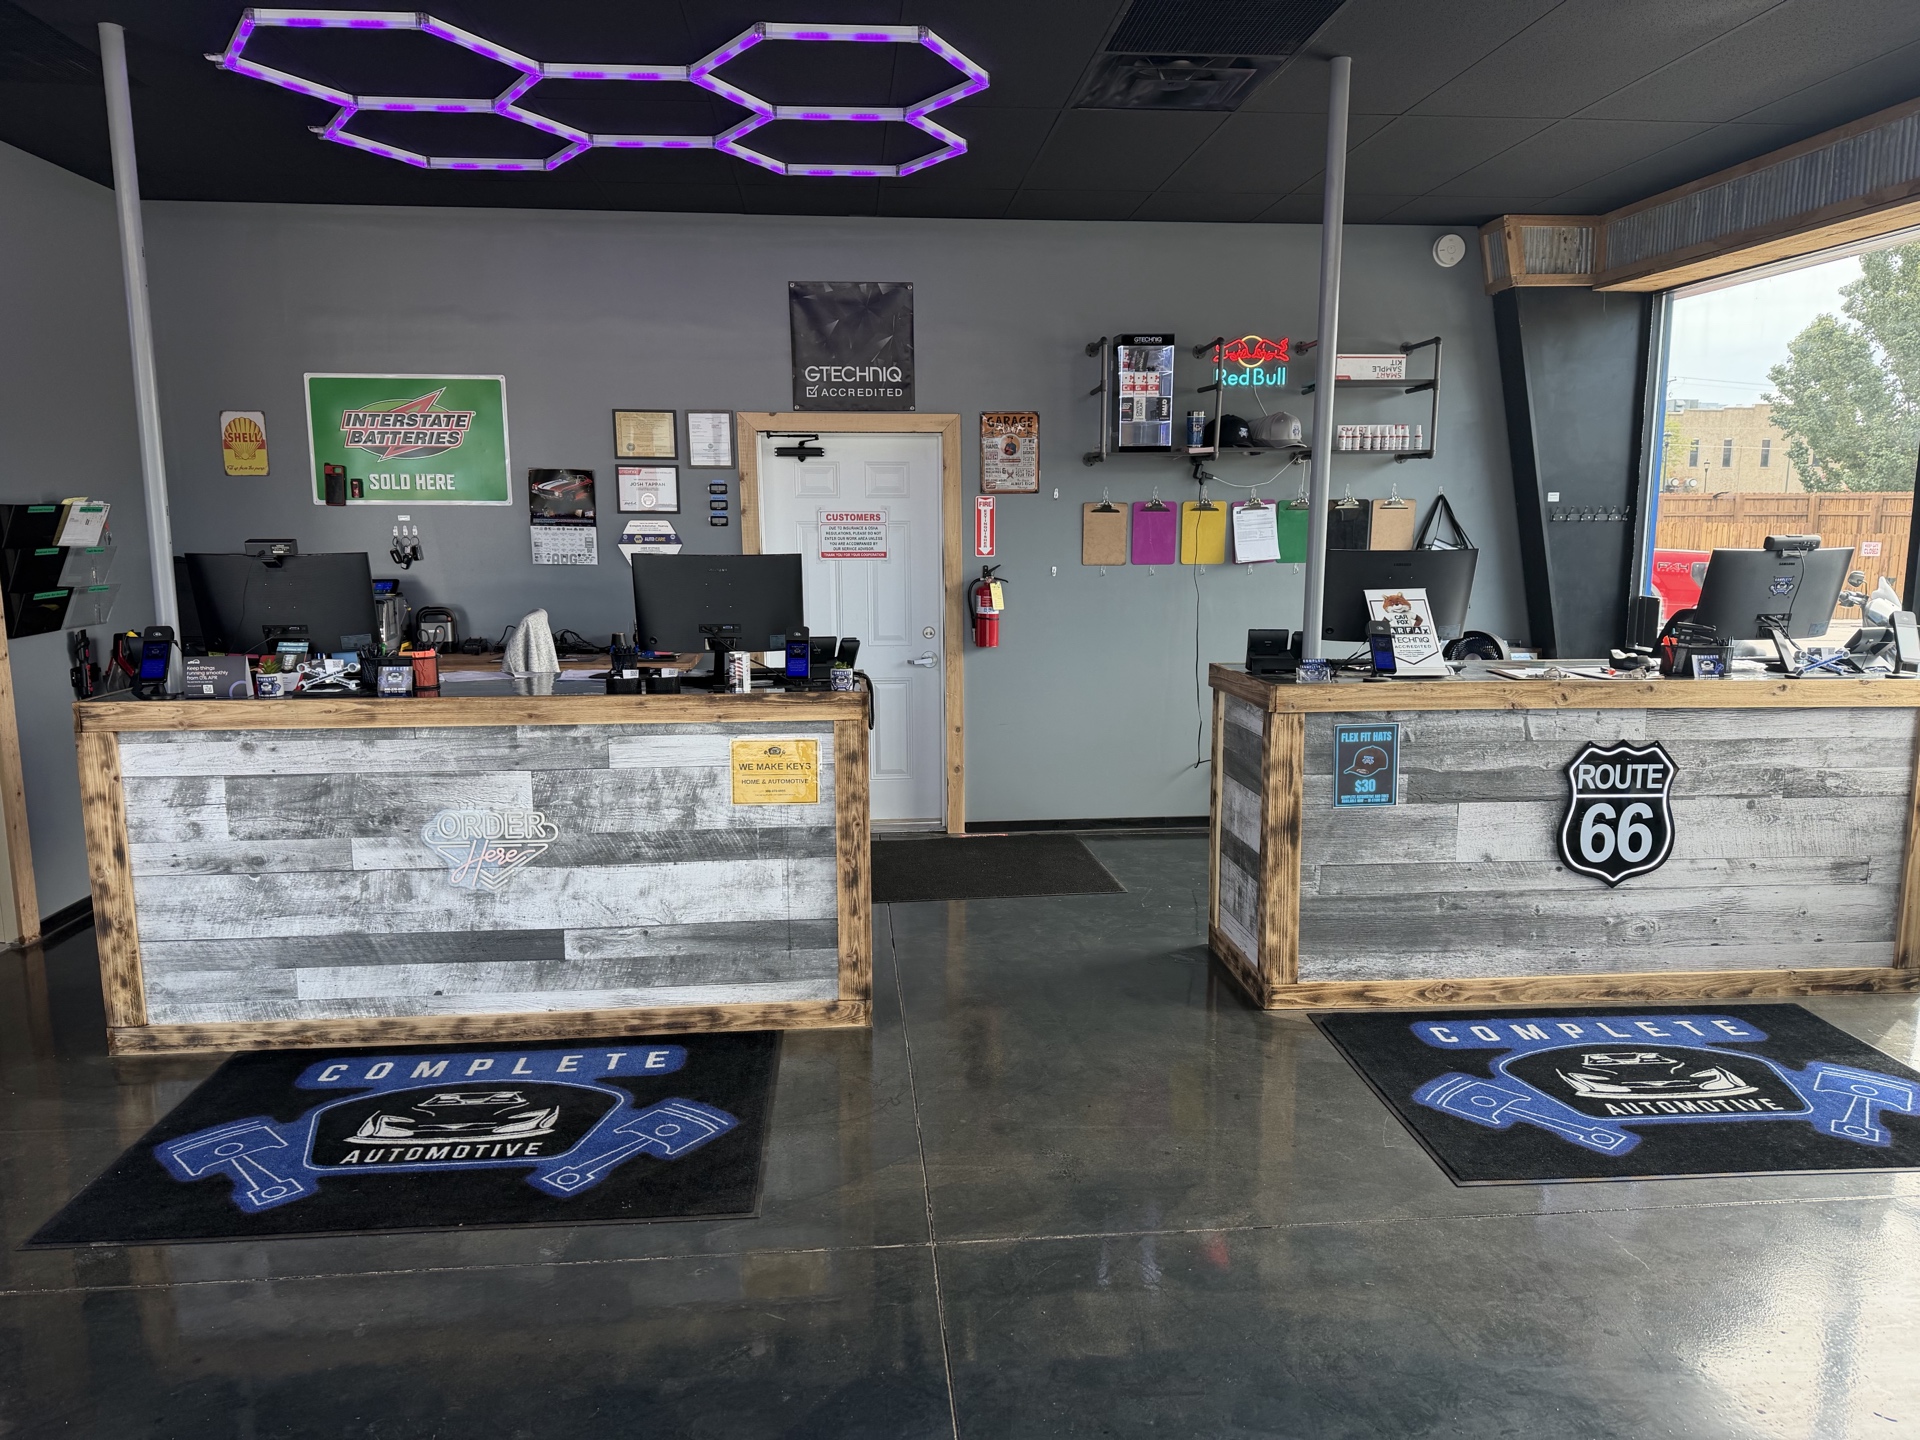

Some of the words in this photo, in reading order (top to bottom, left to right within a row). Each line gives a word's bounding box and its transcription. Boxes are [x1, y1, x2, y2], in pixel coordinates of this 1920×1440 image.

[804, 366, 902, 382] GTECHNIQ
[1216, 367, 1249, 386] Red
[1253, 367, 1286, 385] Bull
[821, 388, 902, 396] ACCREDITED
[344, 413, 469, 428] INTERSTATE
[987, 416, 1033, 428] GARAGE
[228, 433, 260, 443] SHELL
[350, 430, 461, 446] BATTERIES
[369, 474, 410, 490] SOLD
[415, 474, 455, 490] HERE
[552, 553, 577, 564] AUG
[1341, 732, 1358, 742] FLEX
[1360, 732, 1371, 742] FIT
[1373, 732, 1392, 741] HATS
[1578, 764, 1664, 789] ROUTE
[1355, 779, 1376, 793] $30
[437, 812, 546, 840] ORDER
[1580, 802, 1654, 863] 66
[451, 840, 535, 887] Here
[1429, 1019, 1751, 1042] COMPLETE
[317, 1050, 670, 1082] COMPLETE
[1606, 1098, 1785, 1116] AUTOMOTIVE
[340, 1142, 542, 1165] AUTOMOTIVE
